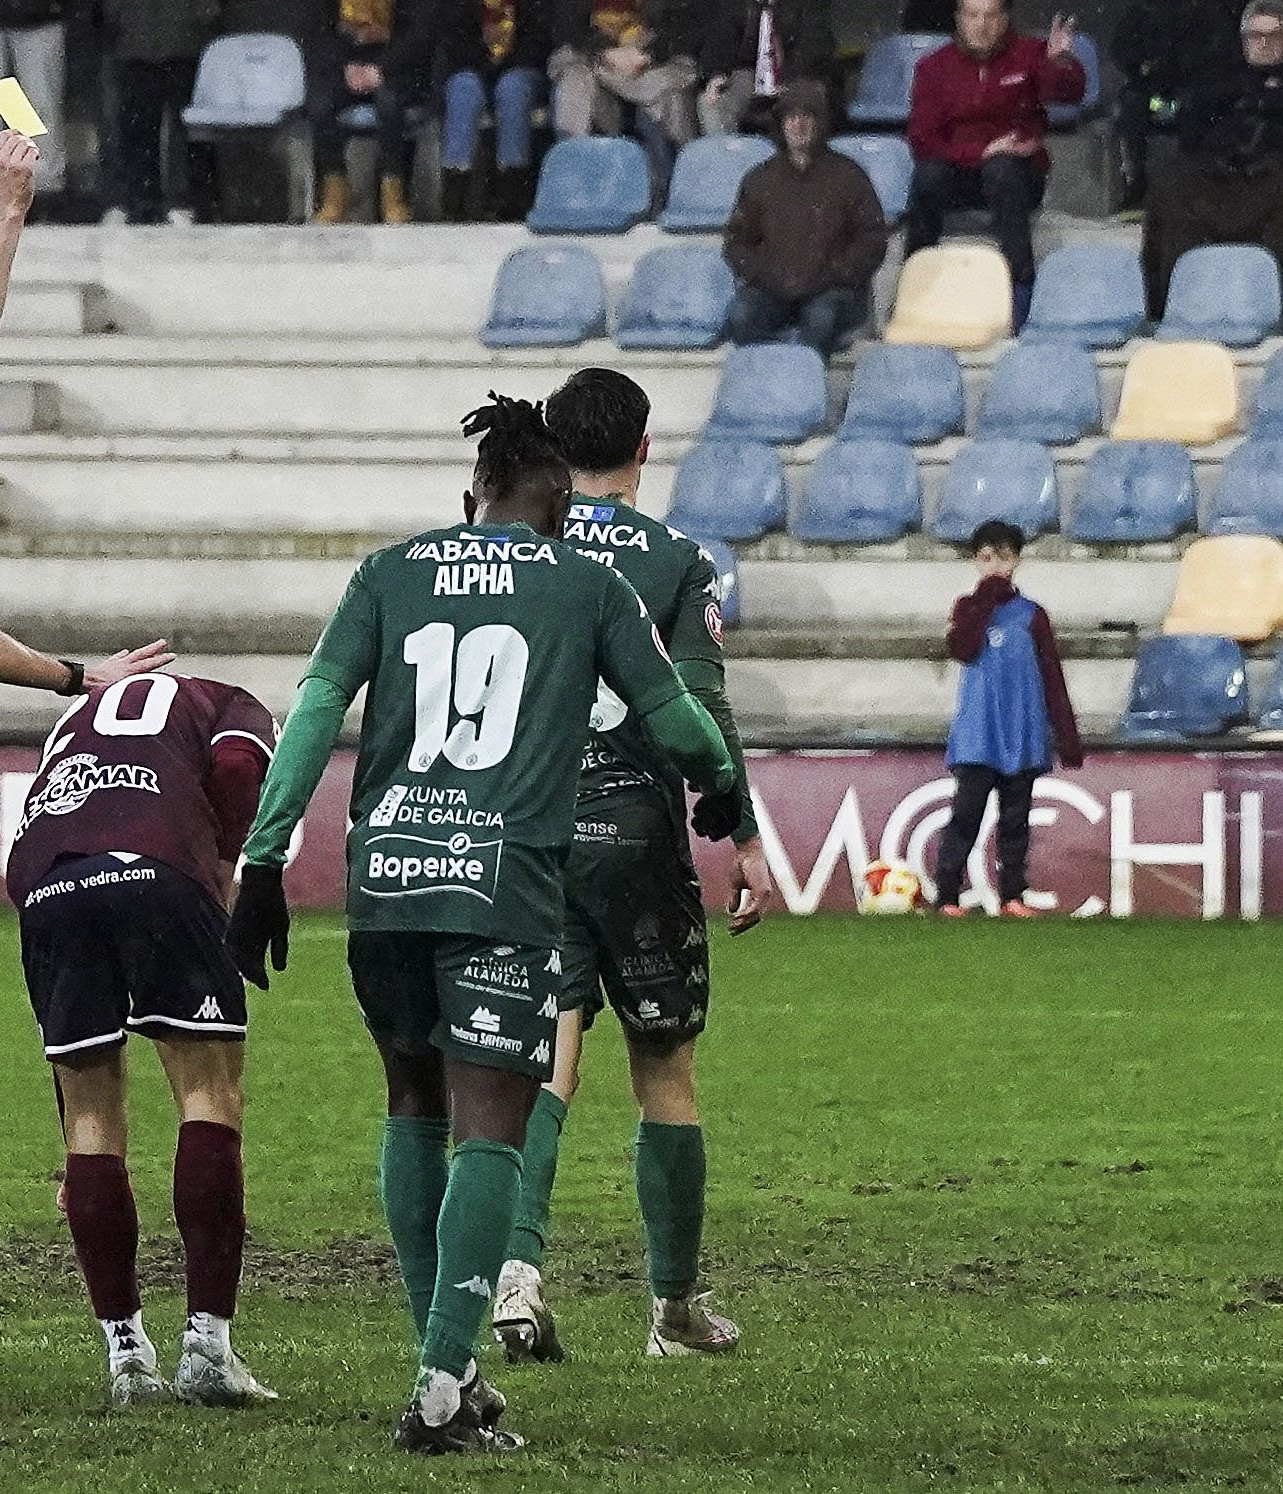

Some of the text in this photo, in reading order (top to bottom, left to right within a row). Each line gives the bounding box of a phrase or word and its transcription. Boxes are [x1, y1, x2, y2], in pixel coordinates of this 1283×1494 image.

[434, 563, 514, 595] ALPHA
[403, 621, 529, 773] 19
[404, 784, 467, 805] XUNTA
[398, 806, 503, 829] DE GALICIA
[369, 852, 484, 886] Bopeixe
[464, 965, 530, 990] ALAMEDA
